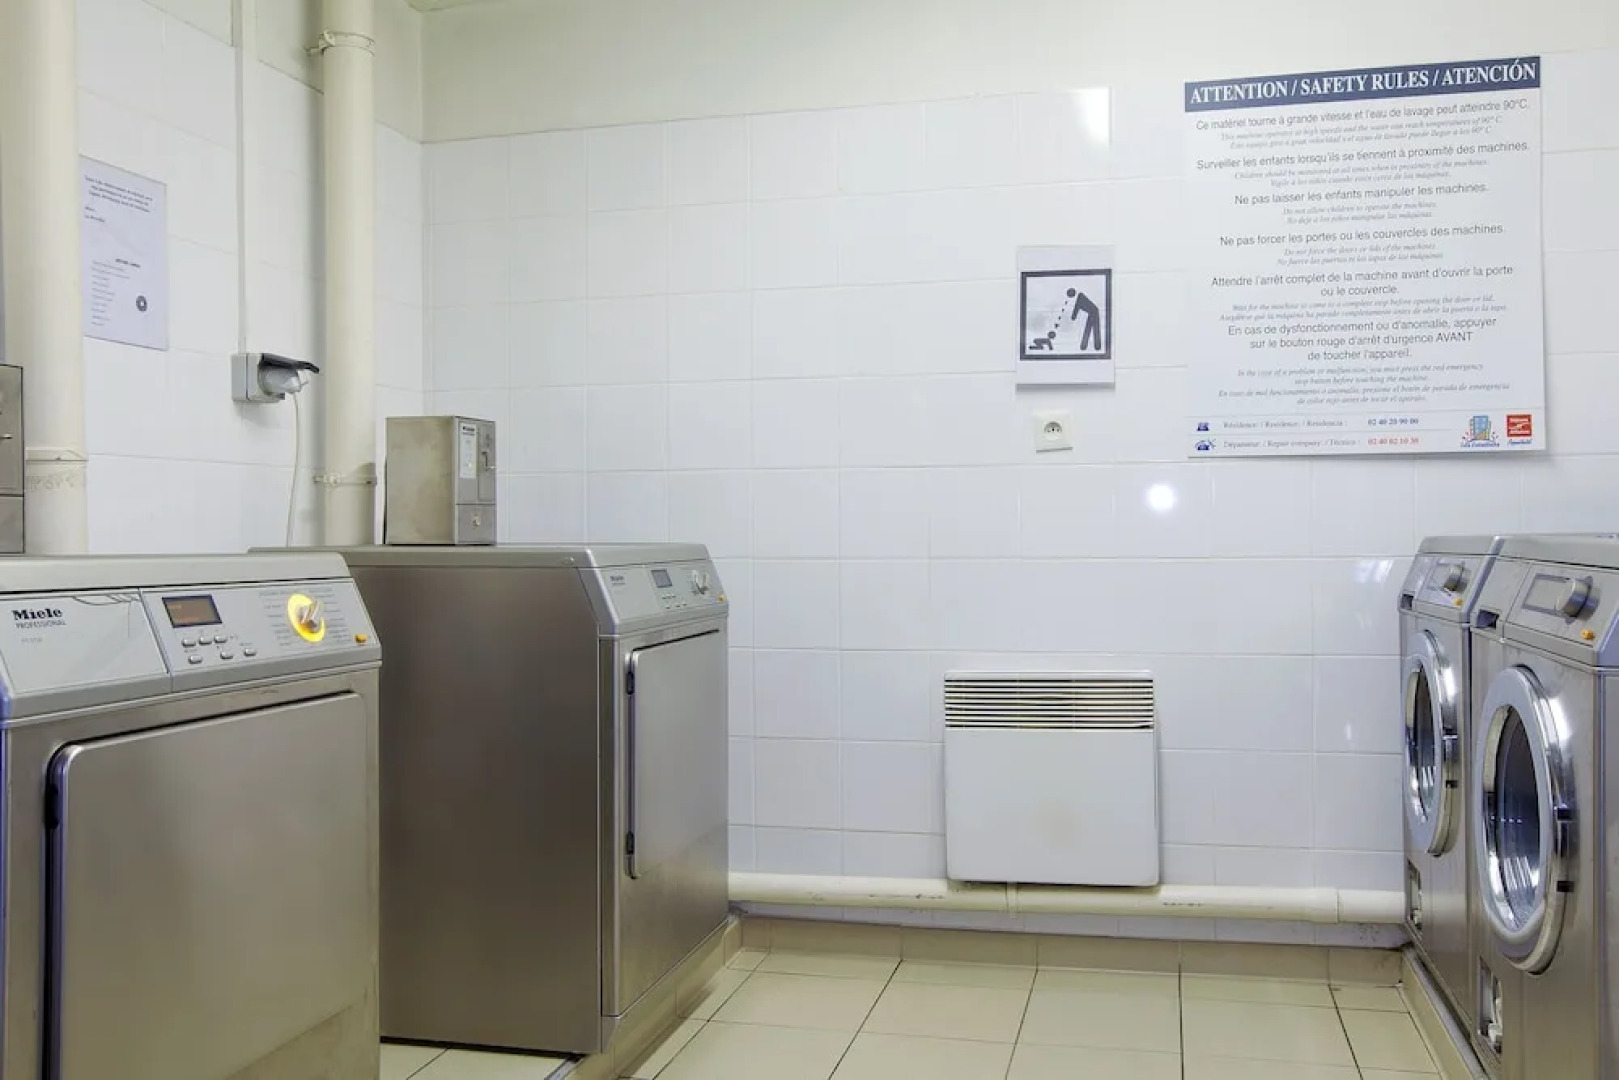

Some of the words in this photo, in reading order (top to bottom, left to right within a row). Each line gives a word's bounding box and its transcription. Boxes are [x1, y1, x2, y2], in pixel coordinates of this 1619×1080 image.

[1190, 80, 1288, 103] ATTENTION
[1291, 79, 1298, 96] /
[1299, 74, 1368, 96] SAFETY
[1371, 70, 1428, 91] RULES
[1432, 69, 1439, 86] /
[1441, 58, 1537, 85] ATENCIÓN
[1196, 119, 1209, 130] Ce
[1210, 116, 1245, 129] matériel
[1247, 114, 1276, 126] tourne
[1278, 114, 1284, 124] à
[1286, 111, 1318, 126] grande
[1320, 109, 1352, 122] vitesse
[1354, 108, 1362, 119] et
[1365, 107, 1386, 119] l'eau
[1388, 106, 1400, 117] de
[1402, 104, 1434, 118] lavage
[1436, 102, 1457, 116] peut
[1459, 99, 1501, 113] atteindre
[1197, 157, 1240, 169] Surveiller
[1242, 156, 1257, 167] les
[1259, 154, 1296, 166] enfants
[1297, 151, 1340, 165] lorsqu'ils
[1341, 153, 1354, 161] se
[1356, 148, 1396, 160] tiennent
[1398, 147, 1405, 157] à
[1407, 144, 1454, 159] proximité
[1455, 143, 1475, 154] des
[1234, 195, 1248, 205] Ne
[1251, 196, 1269, 205] pas
[1271, 192, 1304, 203] laisser
[1307, 191, 1322, 201] les
[1324, 189, 1362, 200] enfants
[1364, 186, 1414, 199] manipuler
[1416, 185, 1432, 195] les
[1219, 236, 1234, 246] Ne
[1236, 237, 1255, 247] pas
[1257, 233, 1285, 244] forcer
[1288, 232, 1303, 243] les
[1306, 231, 1337, 244] portes
[1339, 232, 1353, 240] ou
[1354, 229, 1370, 240] les
[1372, 226, 1428, 239] couvercles
[1430, 225, 1449, 236] des
[1210, 276, 1253, 287] Attendre
[1255, 274, 1283, 285] l'arrêt
[1285, 273, 1325, 286] complet
[1326, 272, 1341, 282] de
[1343, 271, 1353, 281] la
[1354, 269, 1398, 280] machine
[1400, 268, 1429, 278] avant
[1432, 266, 1470, 277] d'ouvrir
[1472, 266, 1483, 275] la
[1485, 264, 1513, 277] porte
[1336, 286, 1346, 295] le
[1347, 284, 1399, 295] couvercle.
[1227, 325, 1242, 335] En
[1263, 324, 1277, 334] de
[1278, 320, 1374, 335] dysfonctionnement
[1375, 322, 1389, 330] ou
[1452, 318, 1497, 329] appuyer
[1268, 338, 1277, 347] le
[1279, 337, 1314, 347] bouton
[1316, 338, 1346, 348] rouge
[1347, 335, 1381, 345] d'arrêt
[1382, 333, 1433, 346] d'urgence
[1434, 331, 1473, 342] AVANT
[1307, 351, 1320, 360] de
[1322, 349, 1360, 360] toucher
[1364, 348, 1412, 360] l'appareil.
[12, 608, 63, 620] Miele
